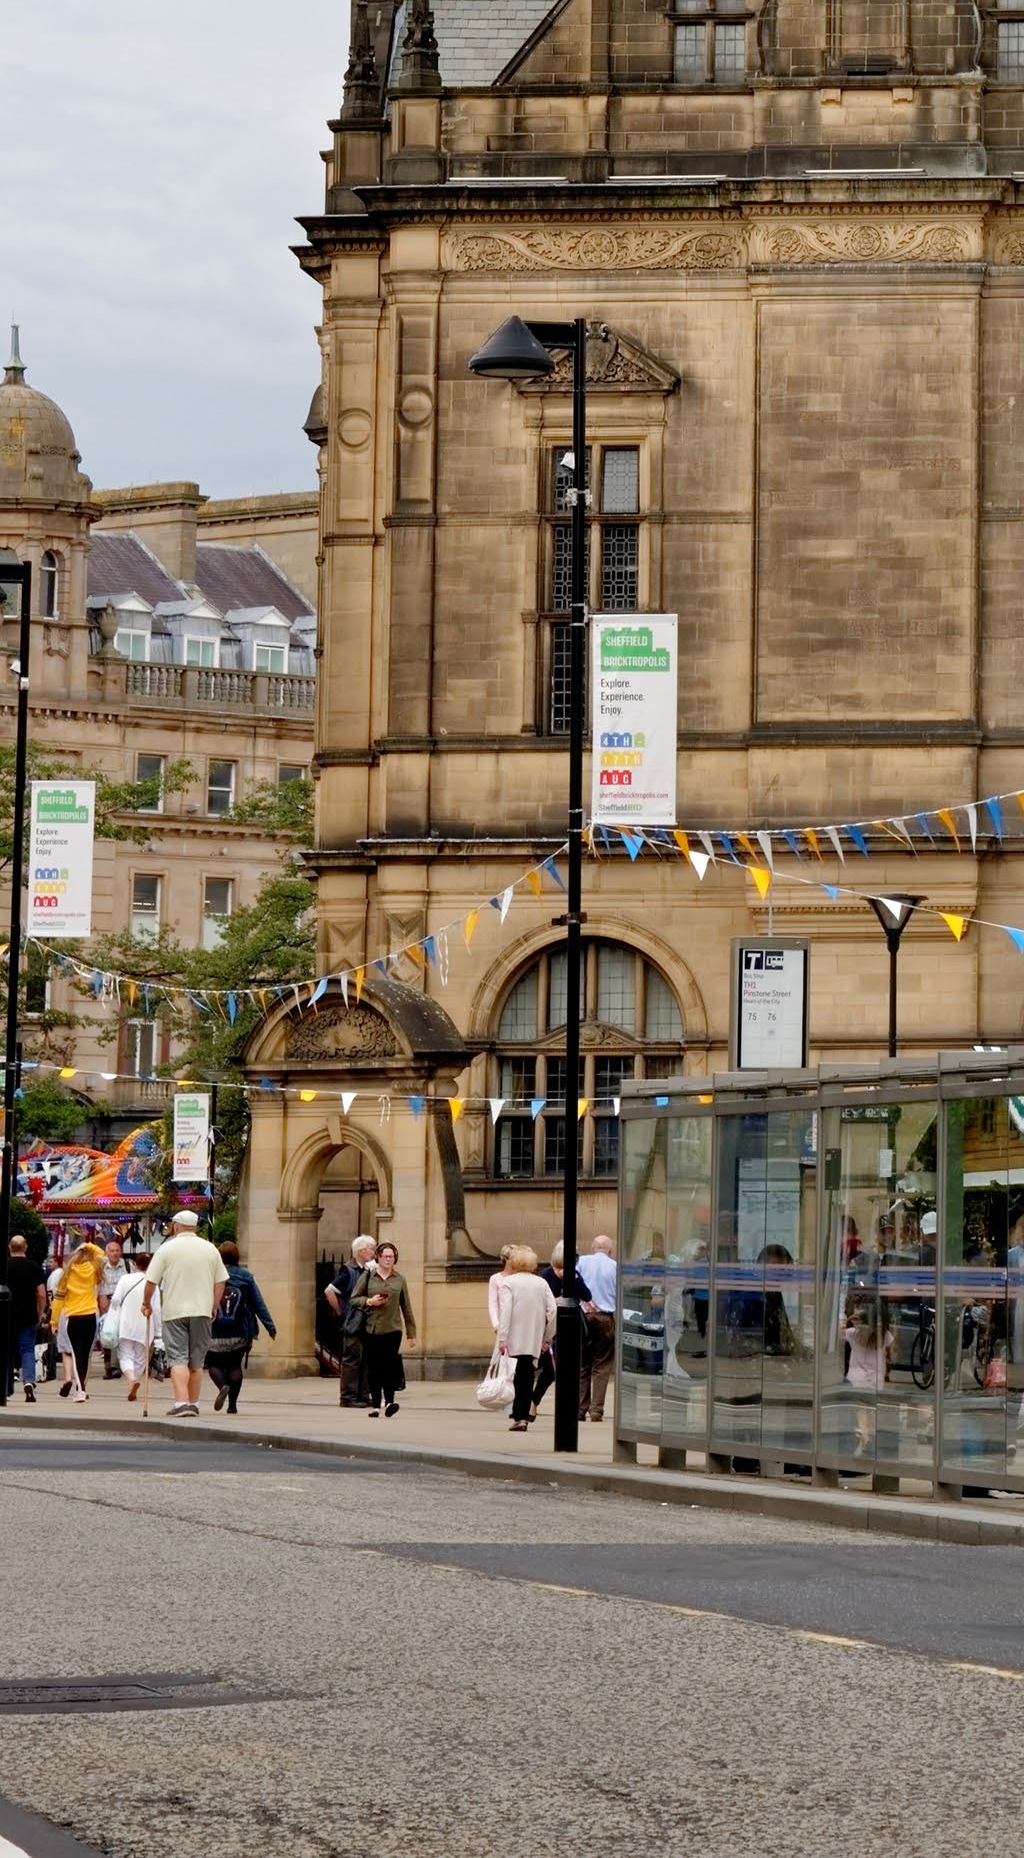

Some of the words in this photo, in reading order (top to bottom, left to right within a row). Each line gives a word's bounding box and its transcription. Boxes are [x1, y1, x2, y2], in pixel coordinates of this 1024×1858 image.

[605, 635, 648, 647] SHEFFIELD
[603, 656, 667, 667] BRICKTROPOLIS
[600, 678, 632, 689] Explore.
[600, 691, 645, 703] Experience.
[600, 704, 623, 716] Enjoy.
[602, 774, 629, 784] AUG
[772, 990, 791, 998] Street
[747, 1012, 757, 1021] 75
[767, 1012, 777, 1022] 76
